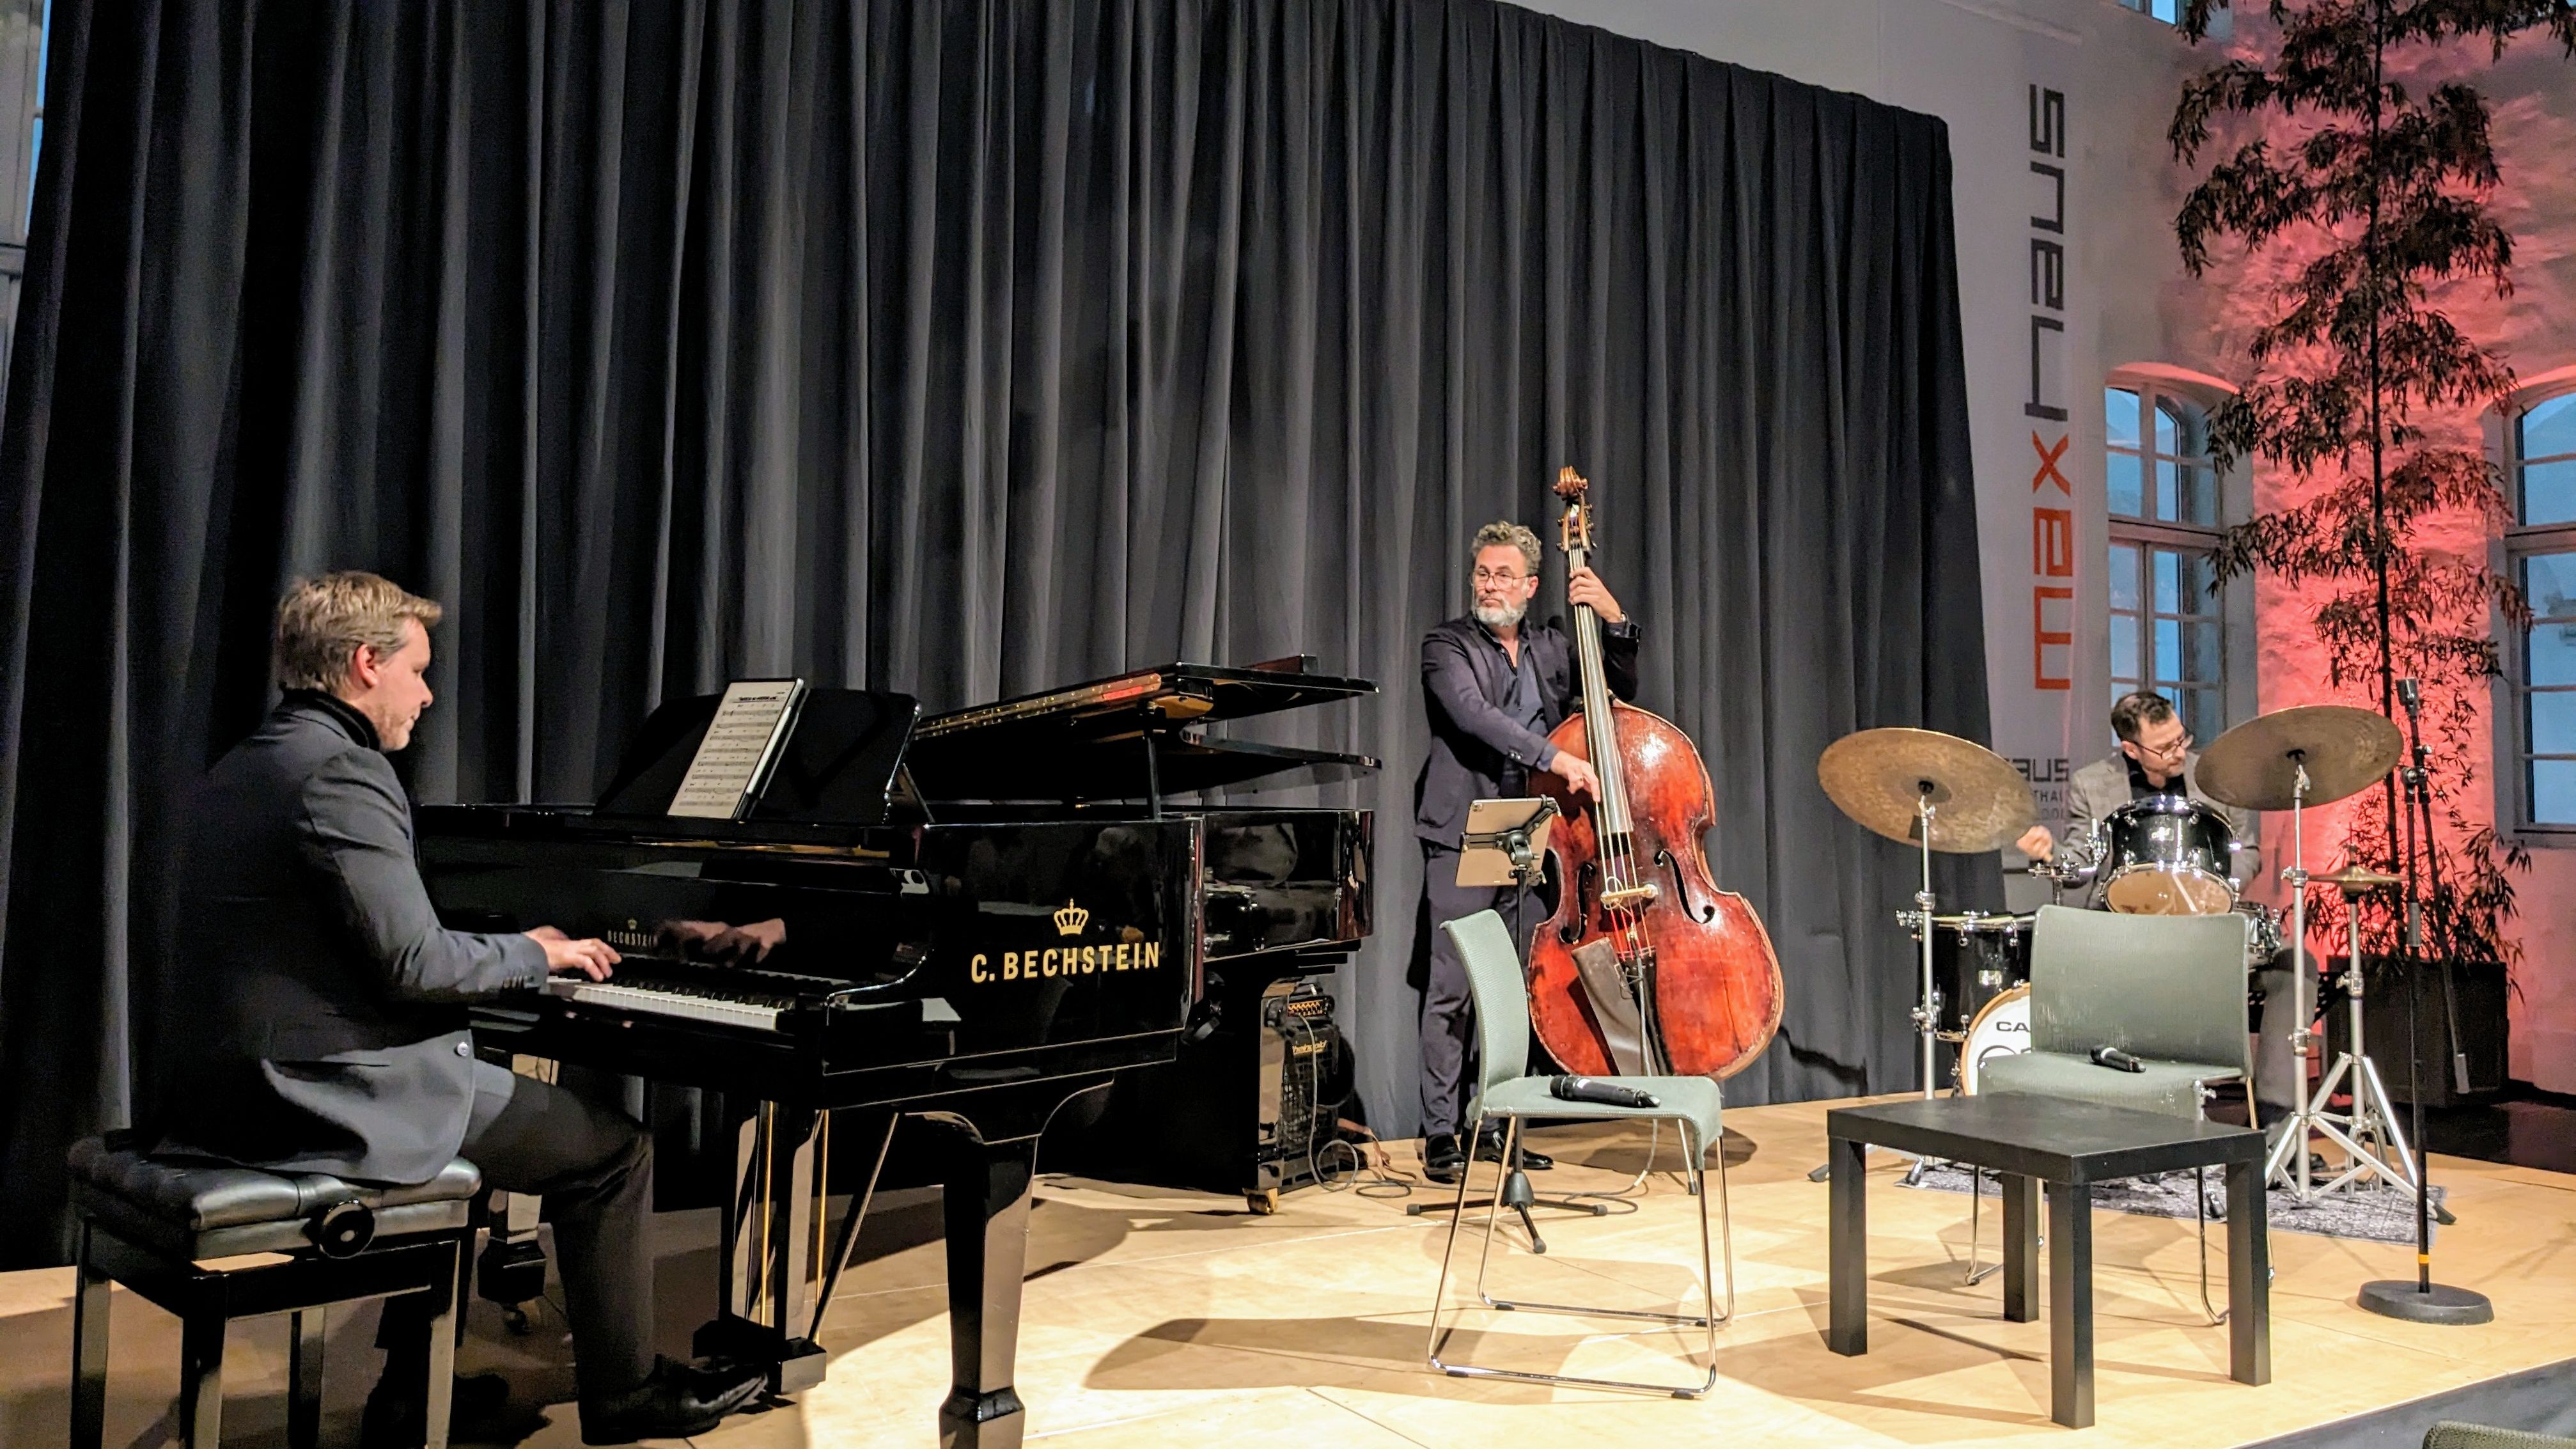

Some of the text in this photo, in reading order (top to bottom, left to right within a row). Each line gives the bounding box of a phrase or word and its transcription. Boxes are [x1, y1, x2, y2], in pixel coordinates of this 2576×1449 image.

[2004, 758, 2069, 781] aus
[971, 941, 1159, 983] C. BECHSTEIN
[1996, 1021, 2030, 1032] CA
